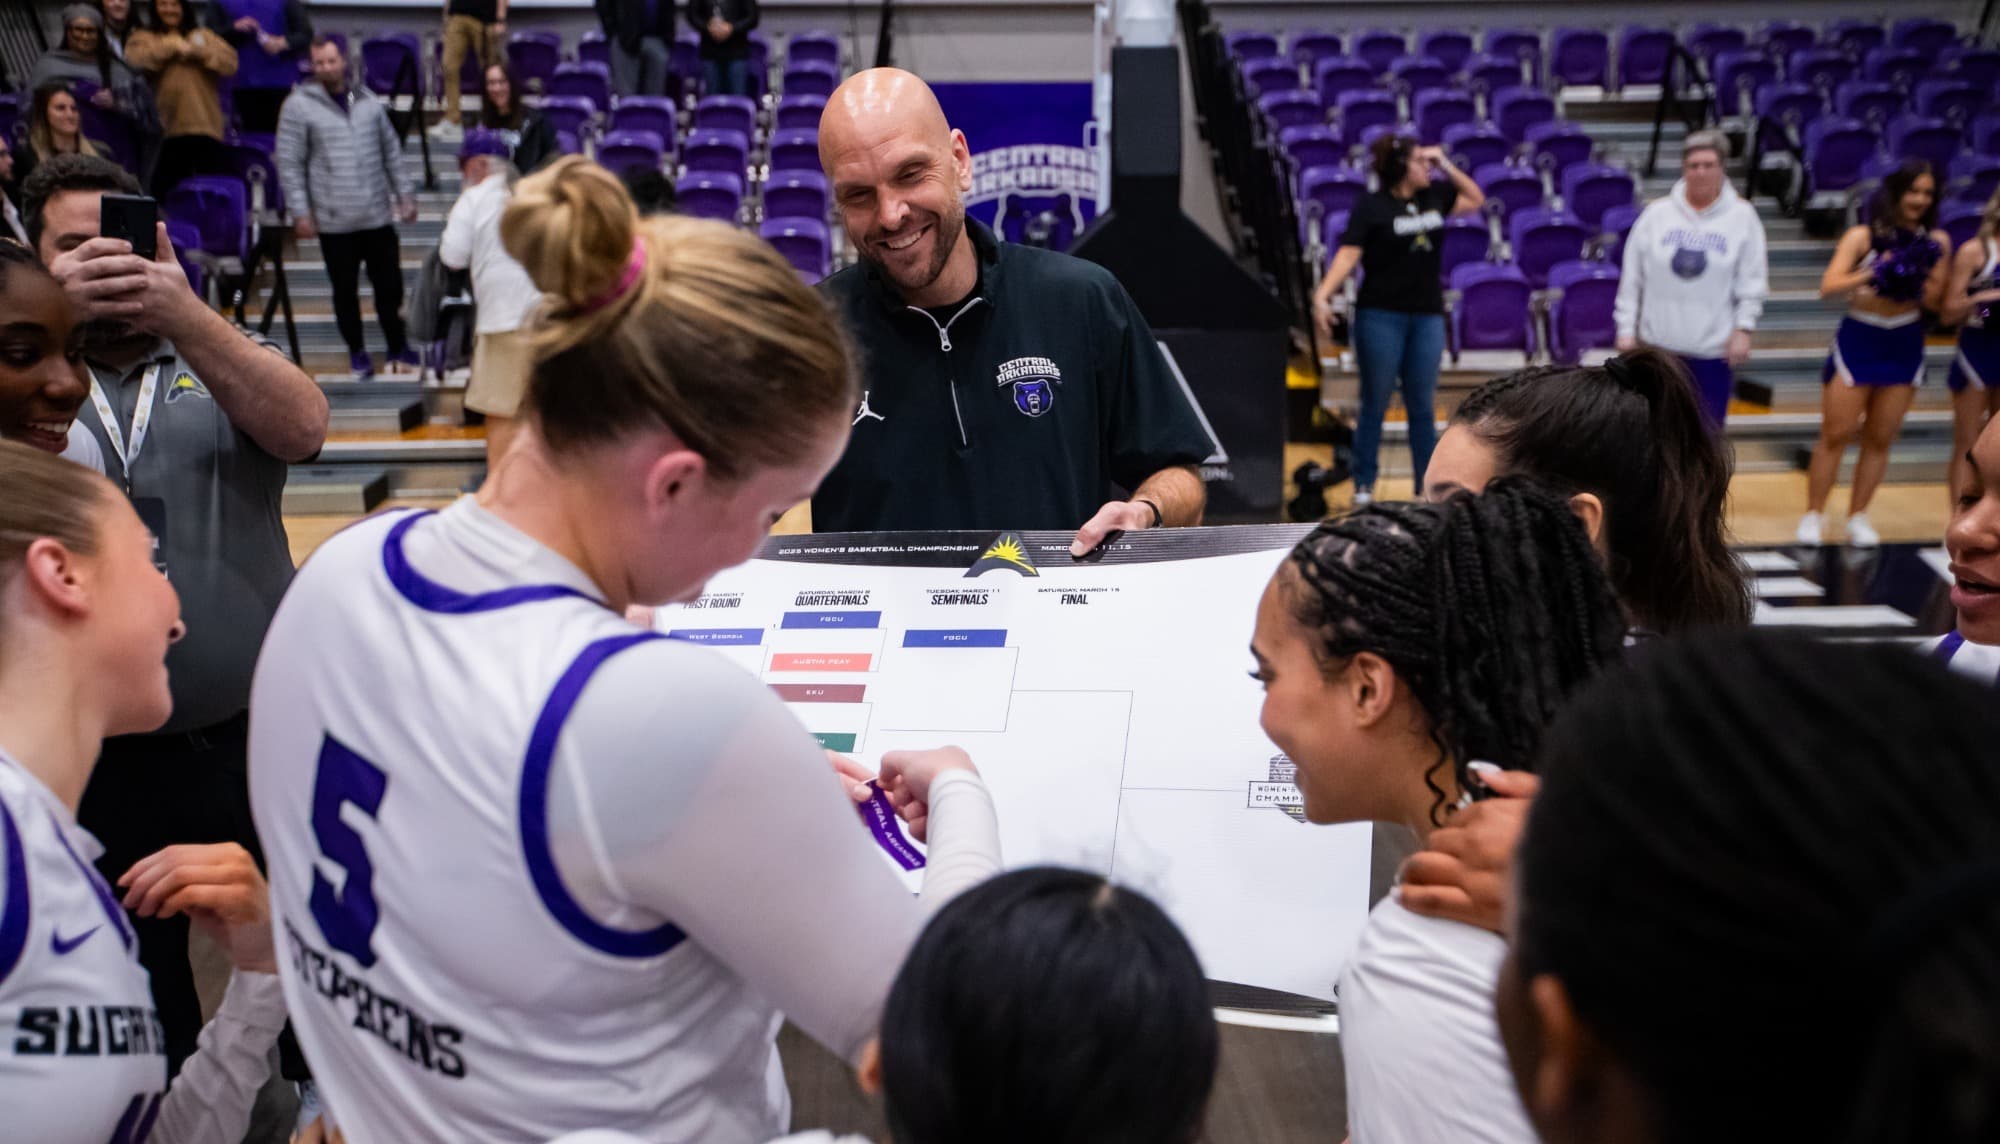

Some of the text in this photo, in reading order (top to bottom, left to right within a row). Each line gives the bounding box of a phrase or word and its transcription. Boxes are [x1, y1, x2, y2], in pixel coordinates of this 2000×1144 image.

[967, 165, 1097, 196] RKANSA
[998, 357, 1056, 373] CENTRAL
[996, 365, 1061, 384] ARKANSAS
[710, 597, 742, 609] ROUND
[795, 594, 870, 606] QUARTERFINALS
[931, 594, 989, 605] SEMIFINALS
[1060, 594, 1089, 605] FINAL
[309, 730, 388, 970] 5
